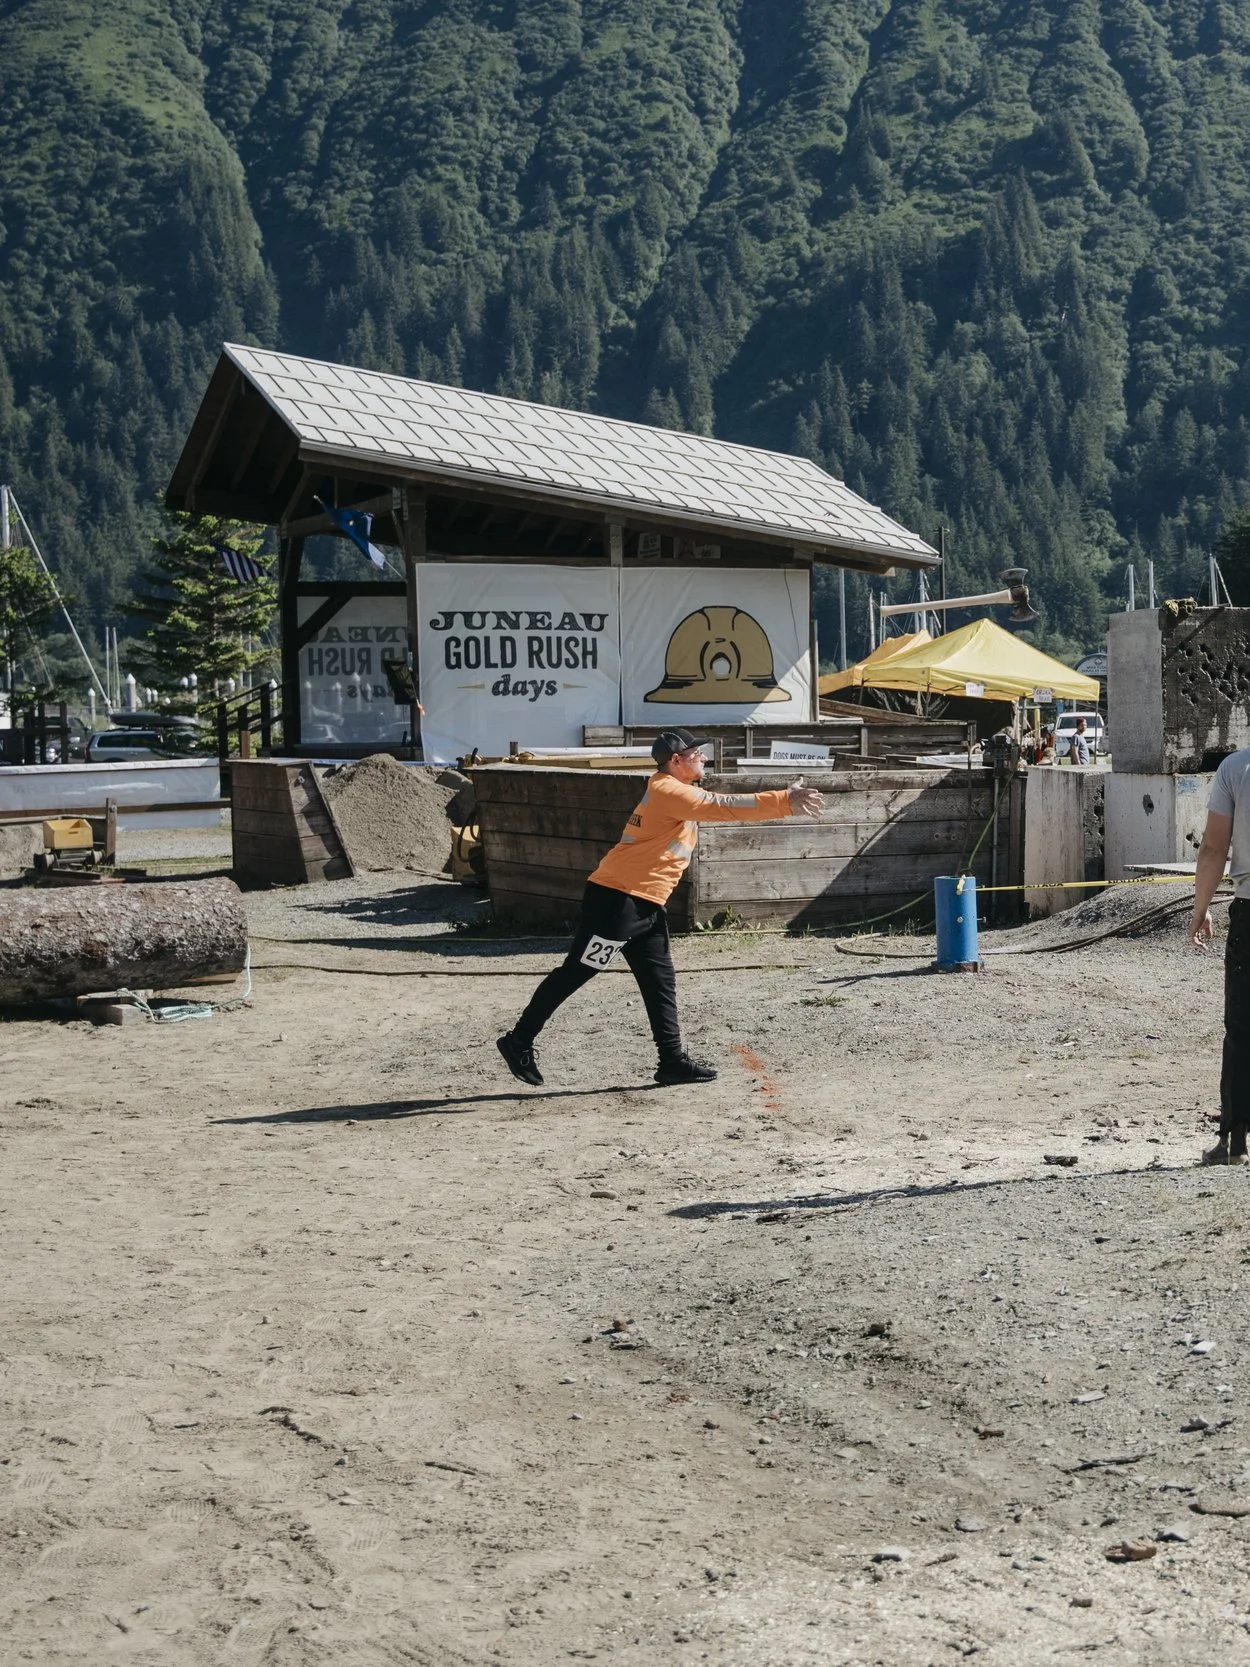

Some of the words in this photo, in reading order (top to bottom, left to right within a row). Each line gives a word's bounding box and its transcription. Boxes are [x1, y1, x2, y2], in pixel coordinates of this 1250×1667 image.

[429, 611, 609, 632] JUNEAU
[444, 636, 518, 670] GOLD
[527, 636, 599, 670] RUSH
[491, 675, 558, 702] days
